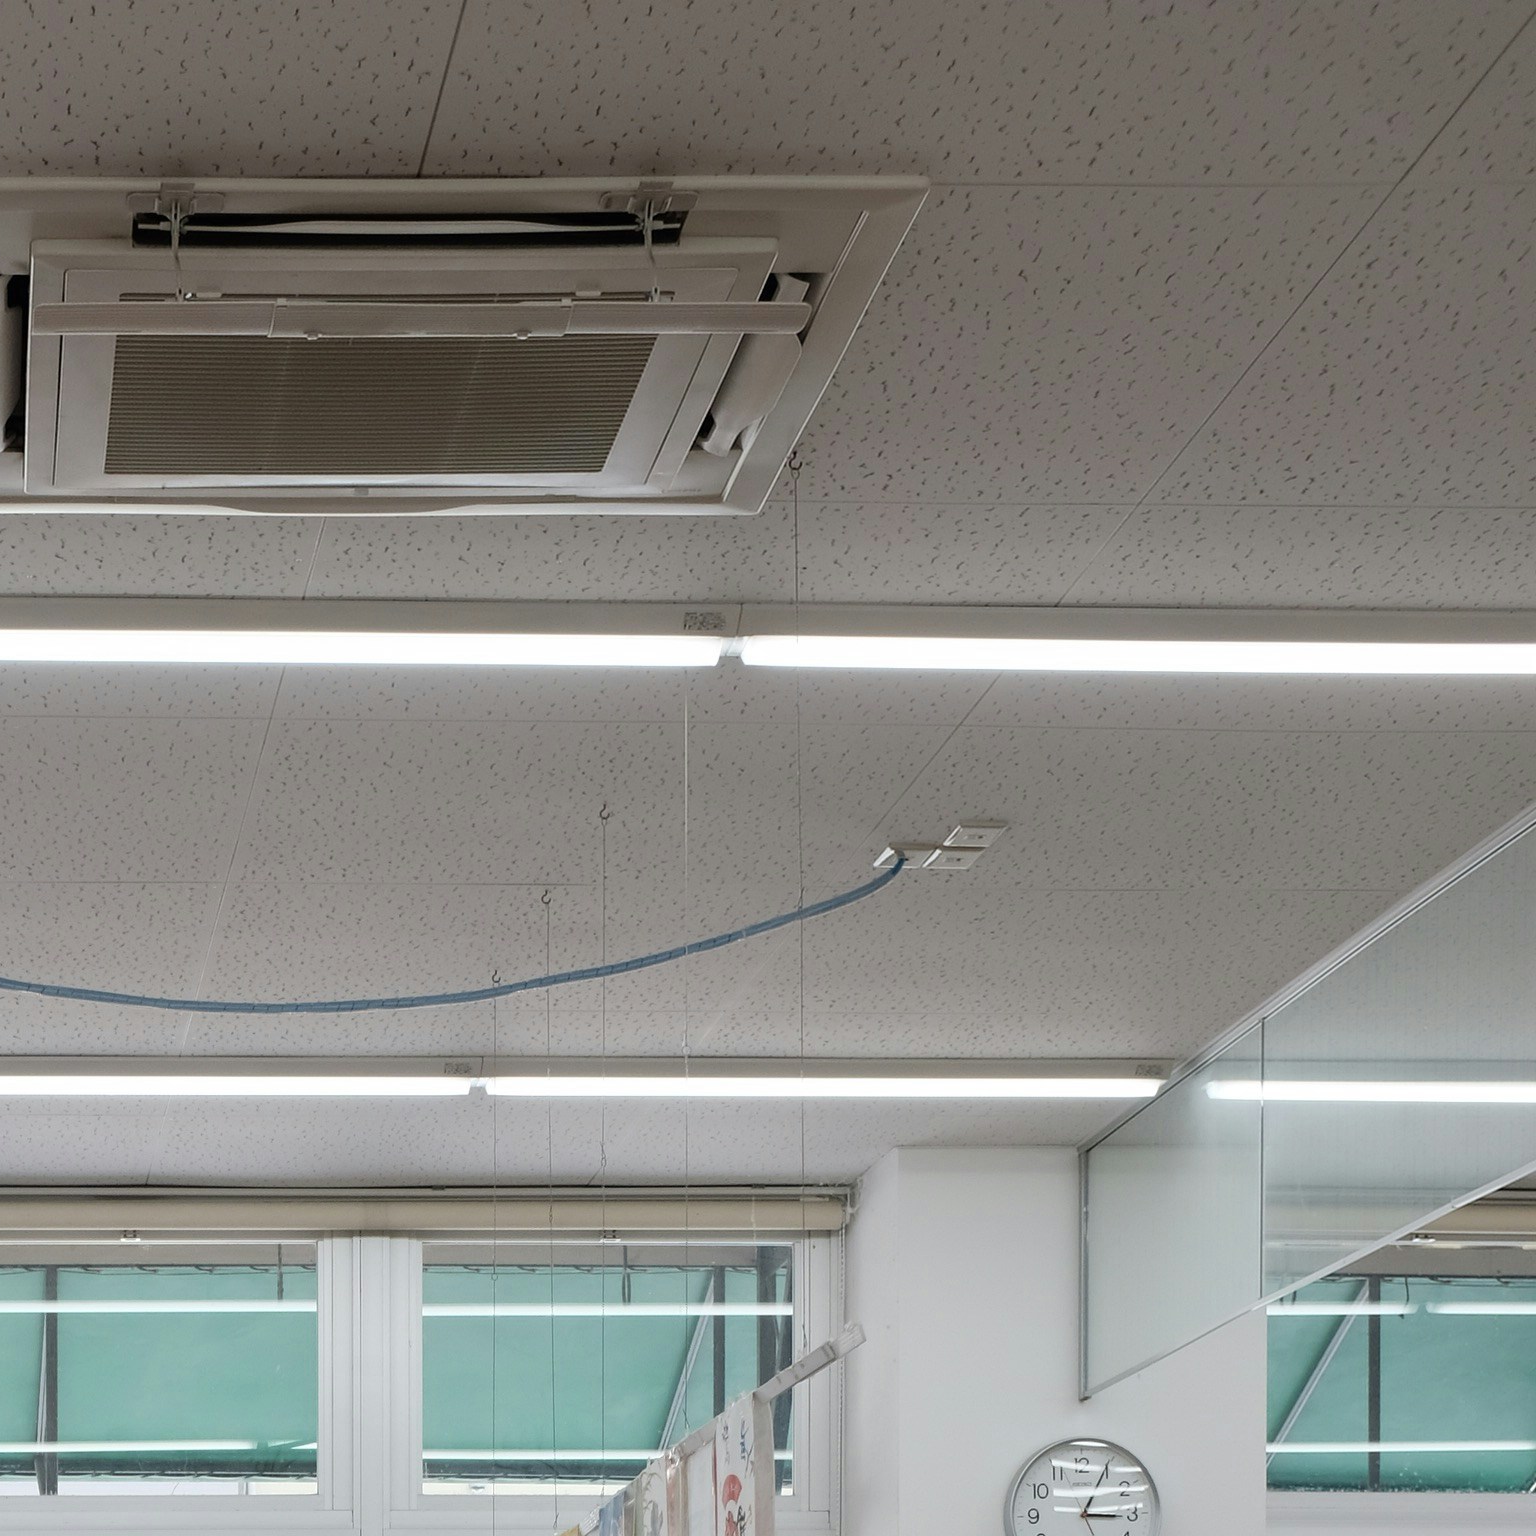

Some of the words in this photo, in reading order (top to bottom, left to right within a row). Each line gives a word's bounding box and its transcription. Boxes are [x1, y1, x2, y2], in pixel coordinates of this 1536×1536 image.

[1052, 1463, 1063, 1481] 11
[1074, 1458, 1089, 1473] 12
[1033, 1483, 1049, 1499] 10
[1119, 1481, 1130, 1497] 2
[1027, 1508, 1040, 1524] 9
[1126, 1506, 1138, 1521] 3
